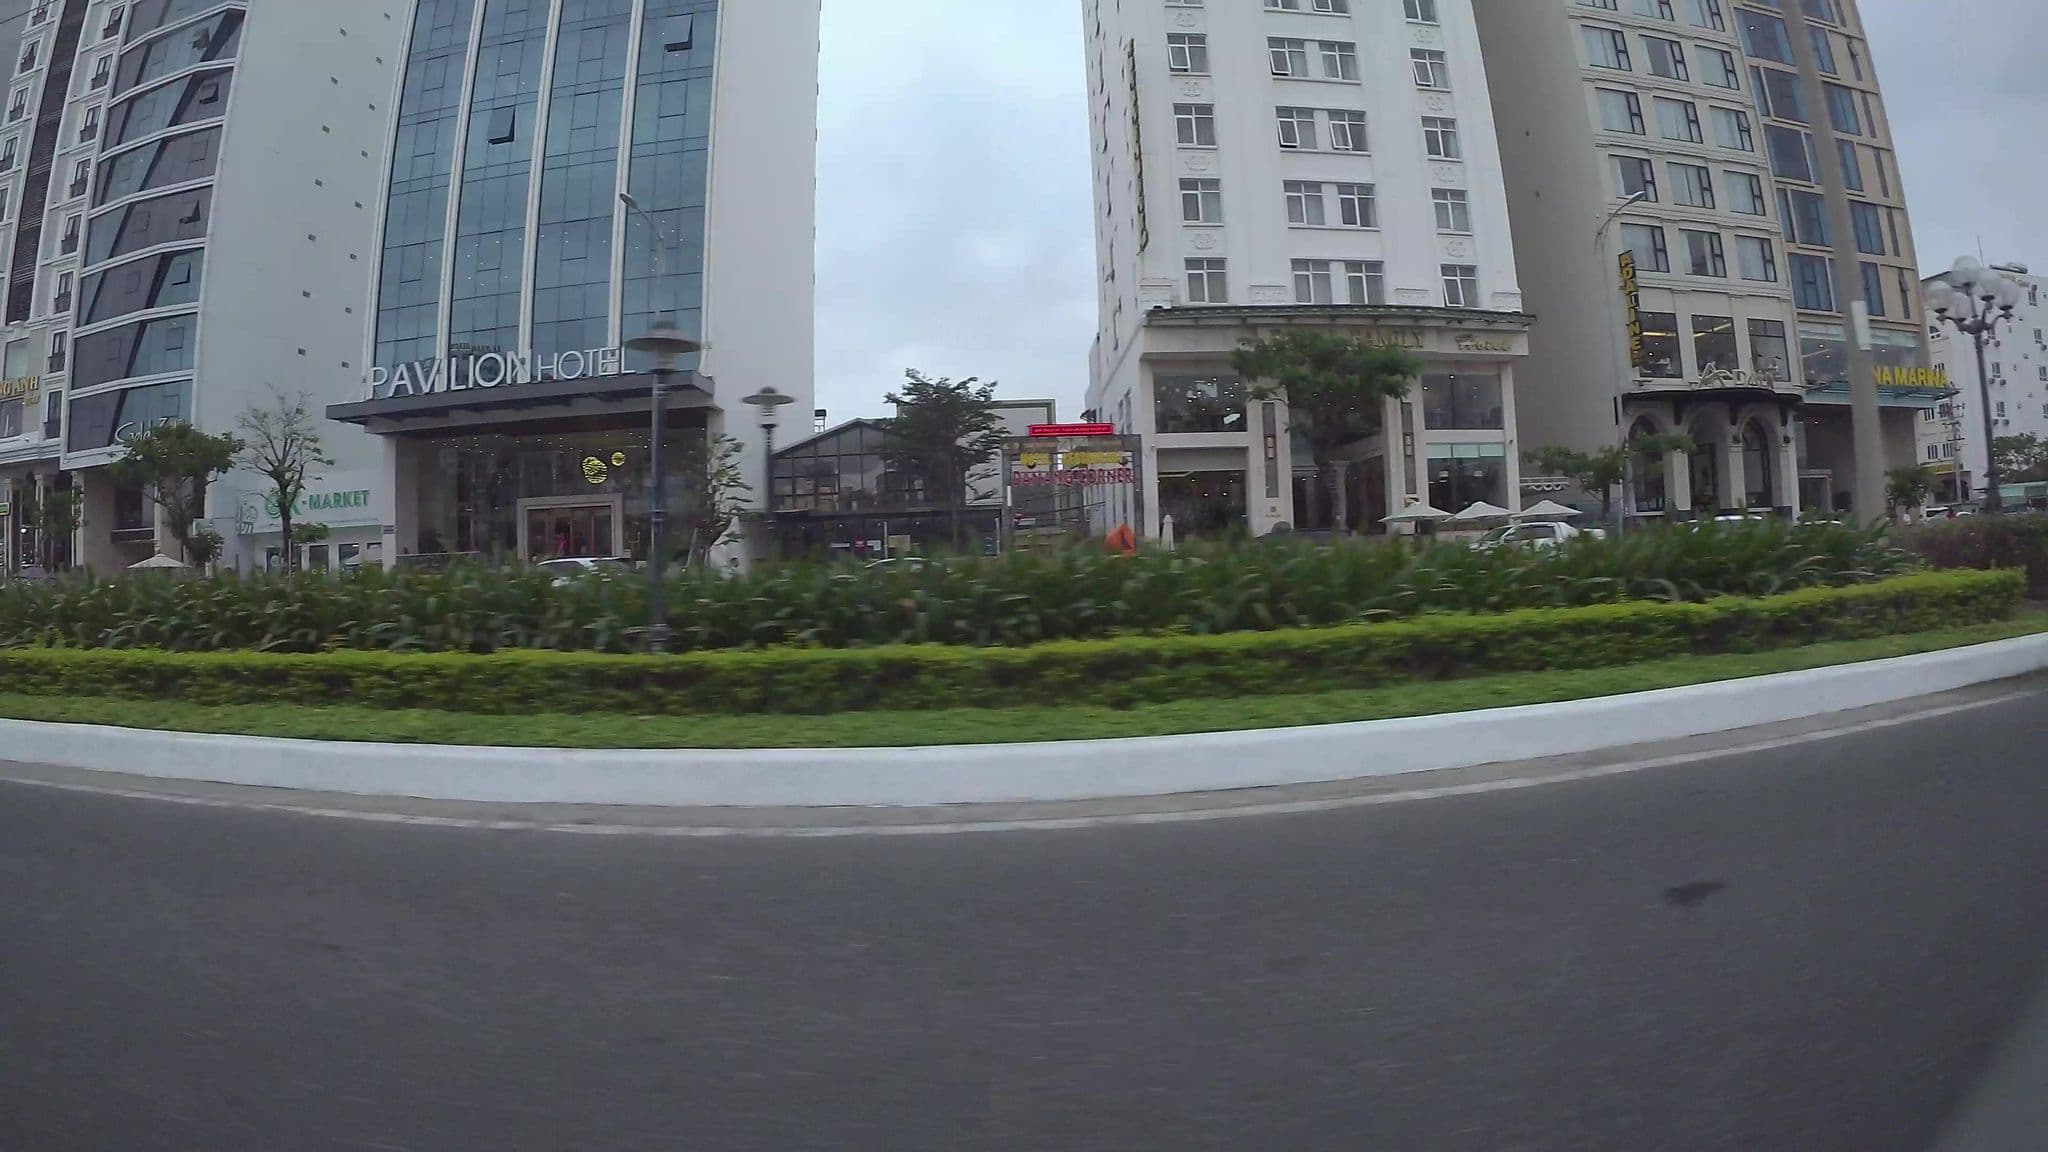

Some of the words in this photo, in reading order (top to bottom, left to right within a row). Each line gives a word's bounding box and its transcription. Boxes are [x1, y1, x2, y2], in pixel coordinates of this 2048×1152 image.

[370, 350, 531, 400] PAVILION
[538, 346, 636, 382] HOTEL
[309, 490, 370, 511] MARKET
